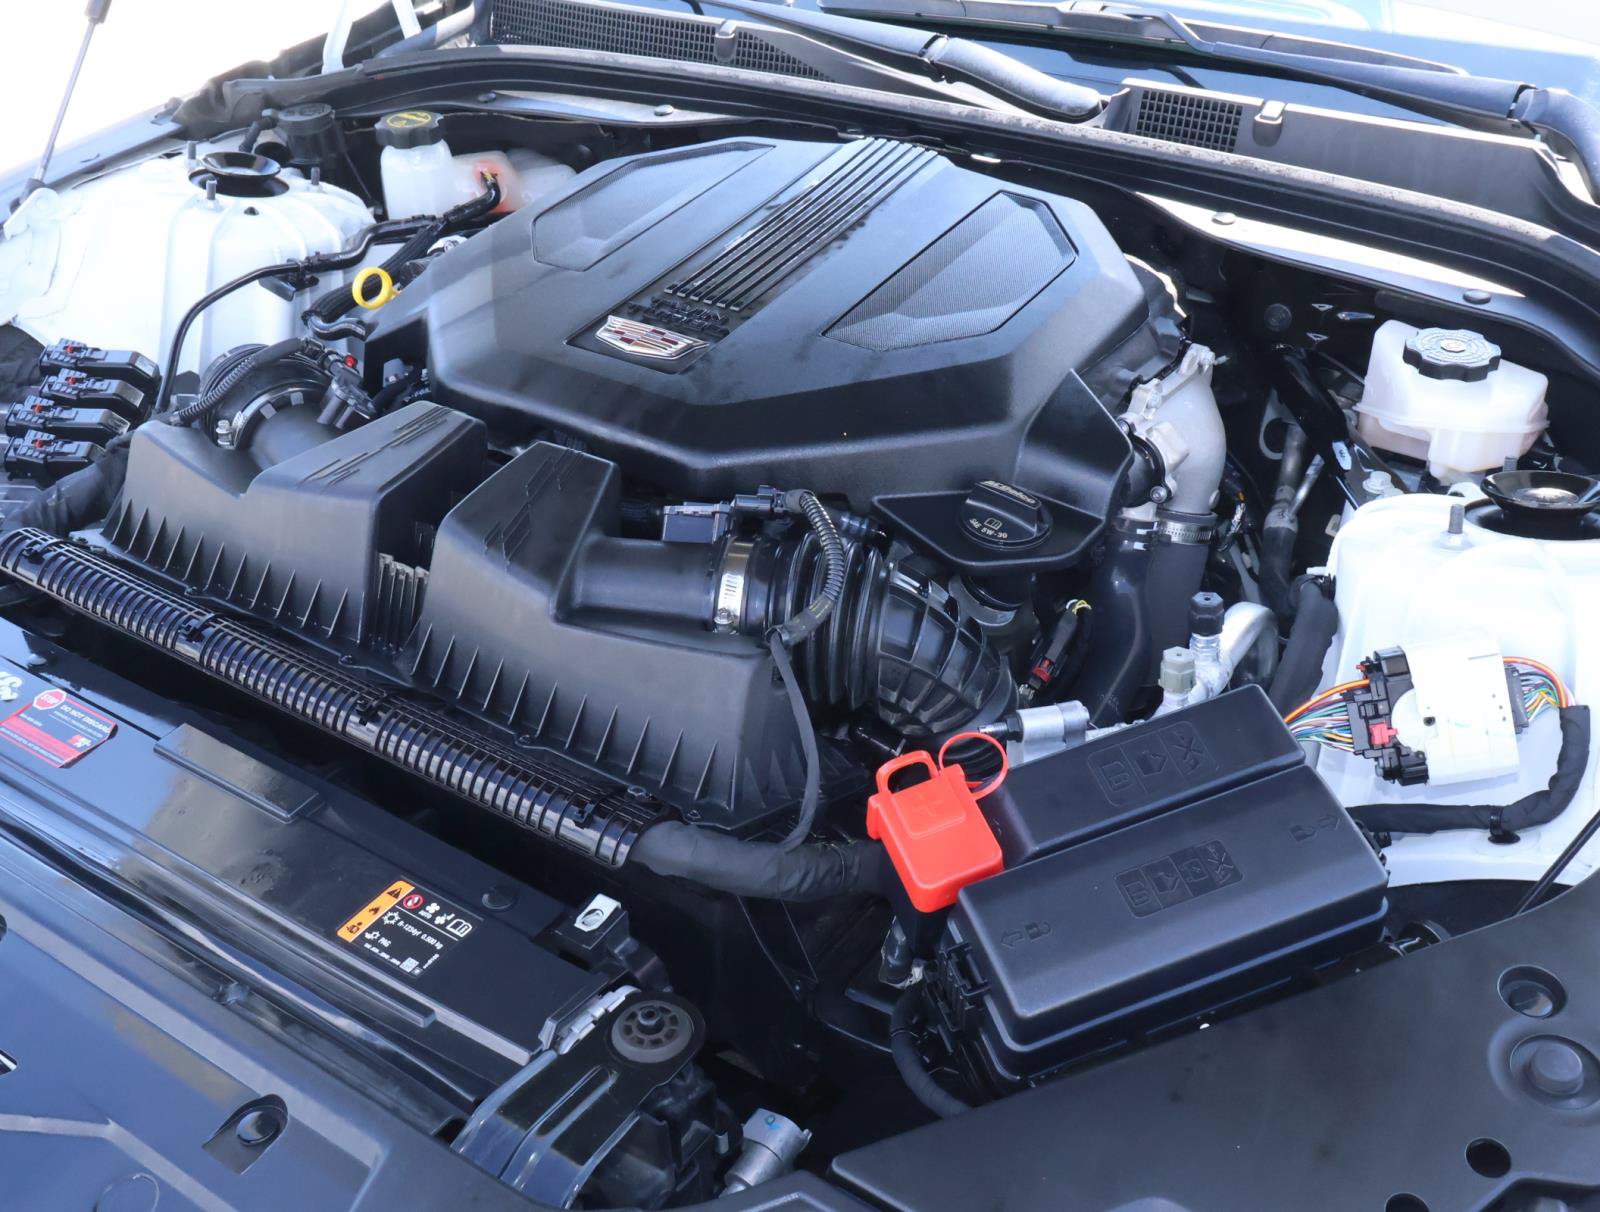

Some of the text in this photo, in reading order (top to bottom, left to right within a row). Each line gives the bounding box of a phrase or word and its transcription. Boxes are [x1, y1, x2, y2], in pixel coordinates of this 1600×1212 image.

[970, 519, 1008, 539] SAE 5W-30
[61, 704, 71, 712] DO
